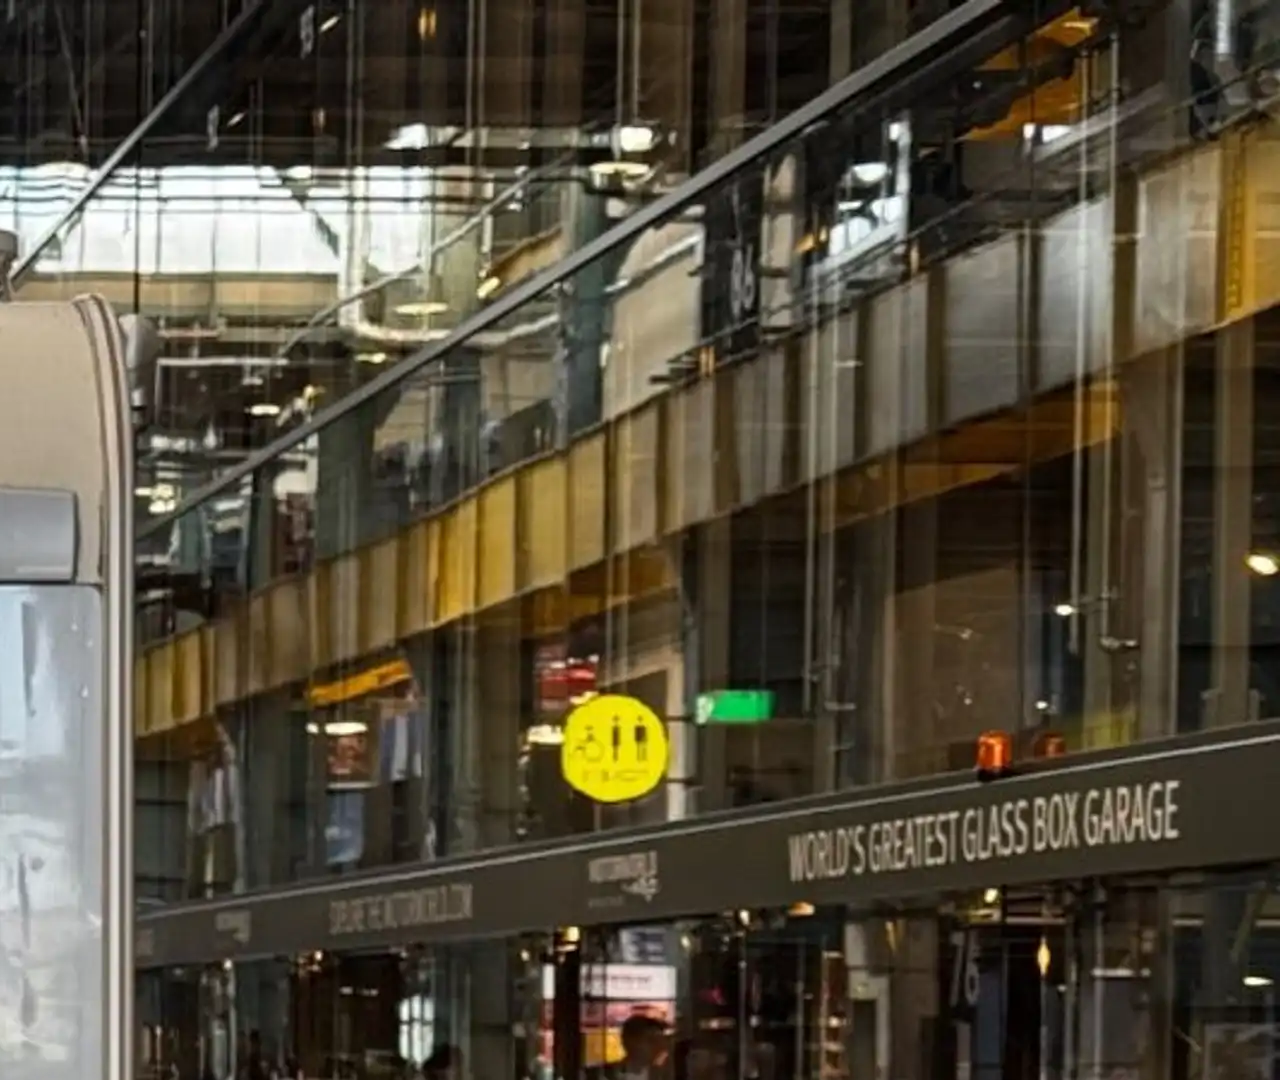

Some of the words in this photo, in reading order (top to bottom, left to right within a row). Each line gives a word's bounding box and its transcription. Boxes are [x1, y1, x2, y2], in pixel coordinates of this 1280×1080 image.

[788, 824, 867, 882] WORLD'S
[868, 811, 960, 873] GREATEST
[961, 799, 1029, 862] GLASS
[1032, 792, 1081, 852] BOX
[1082, 779, 1182, 847] GARAGE
